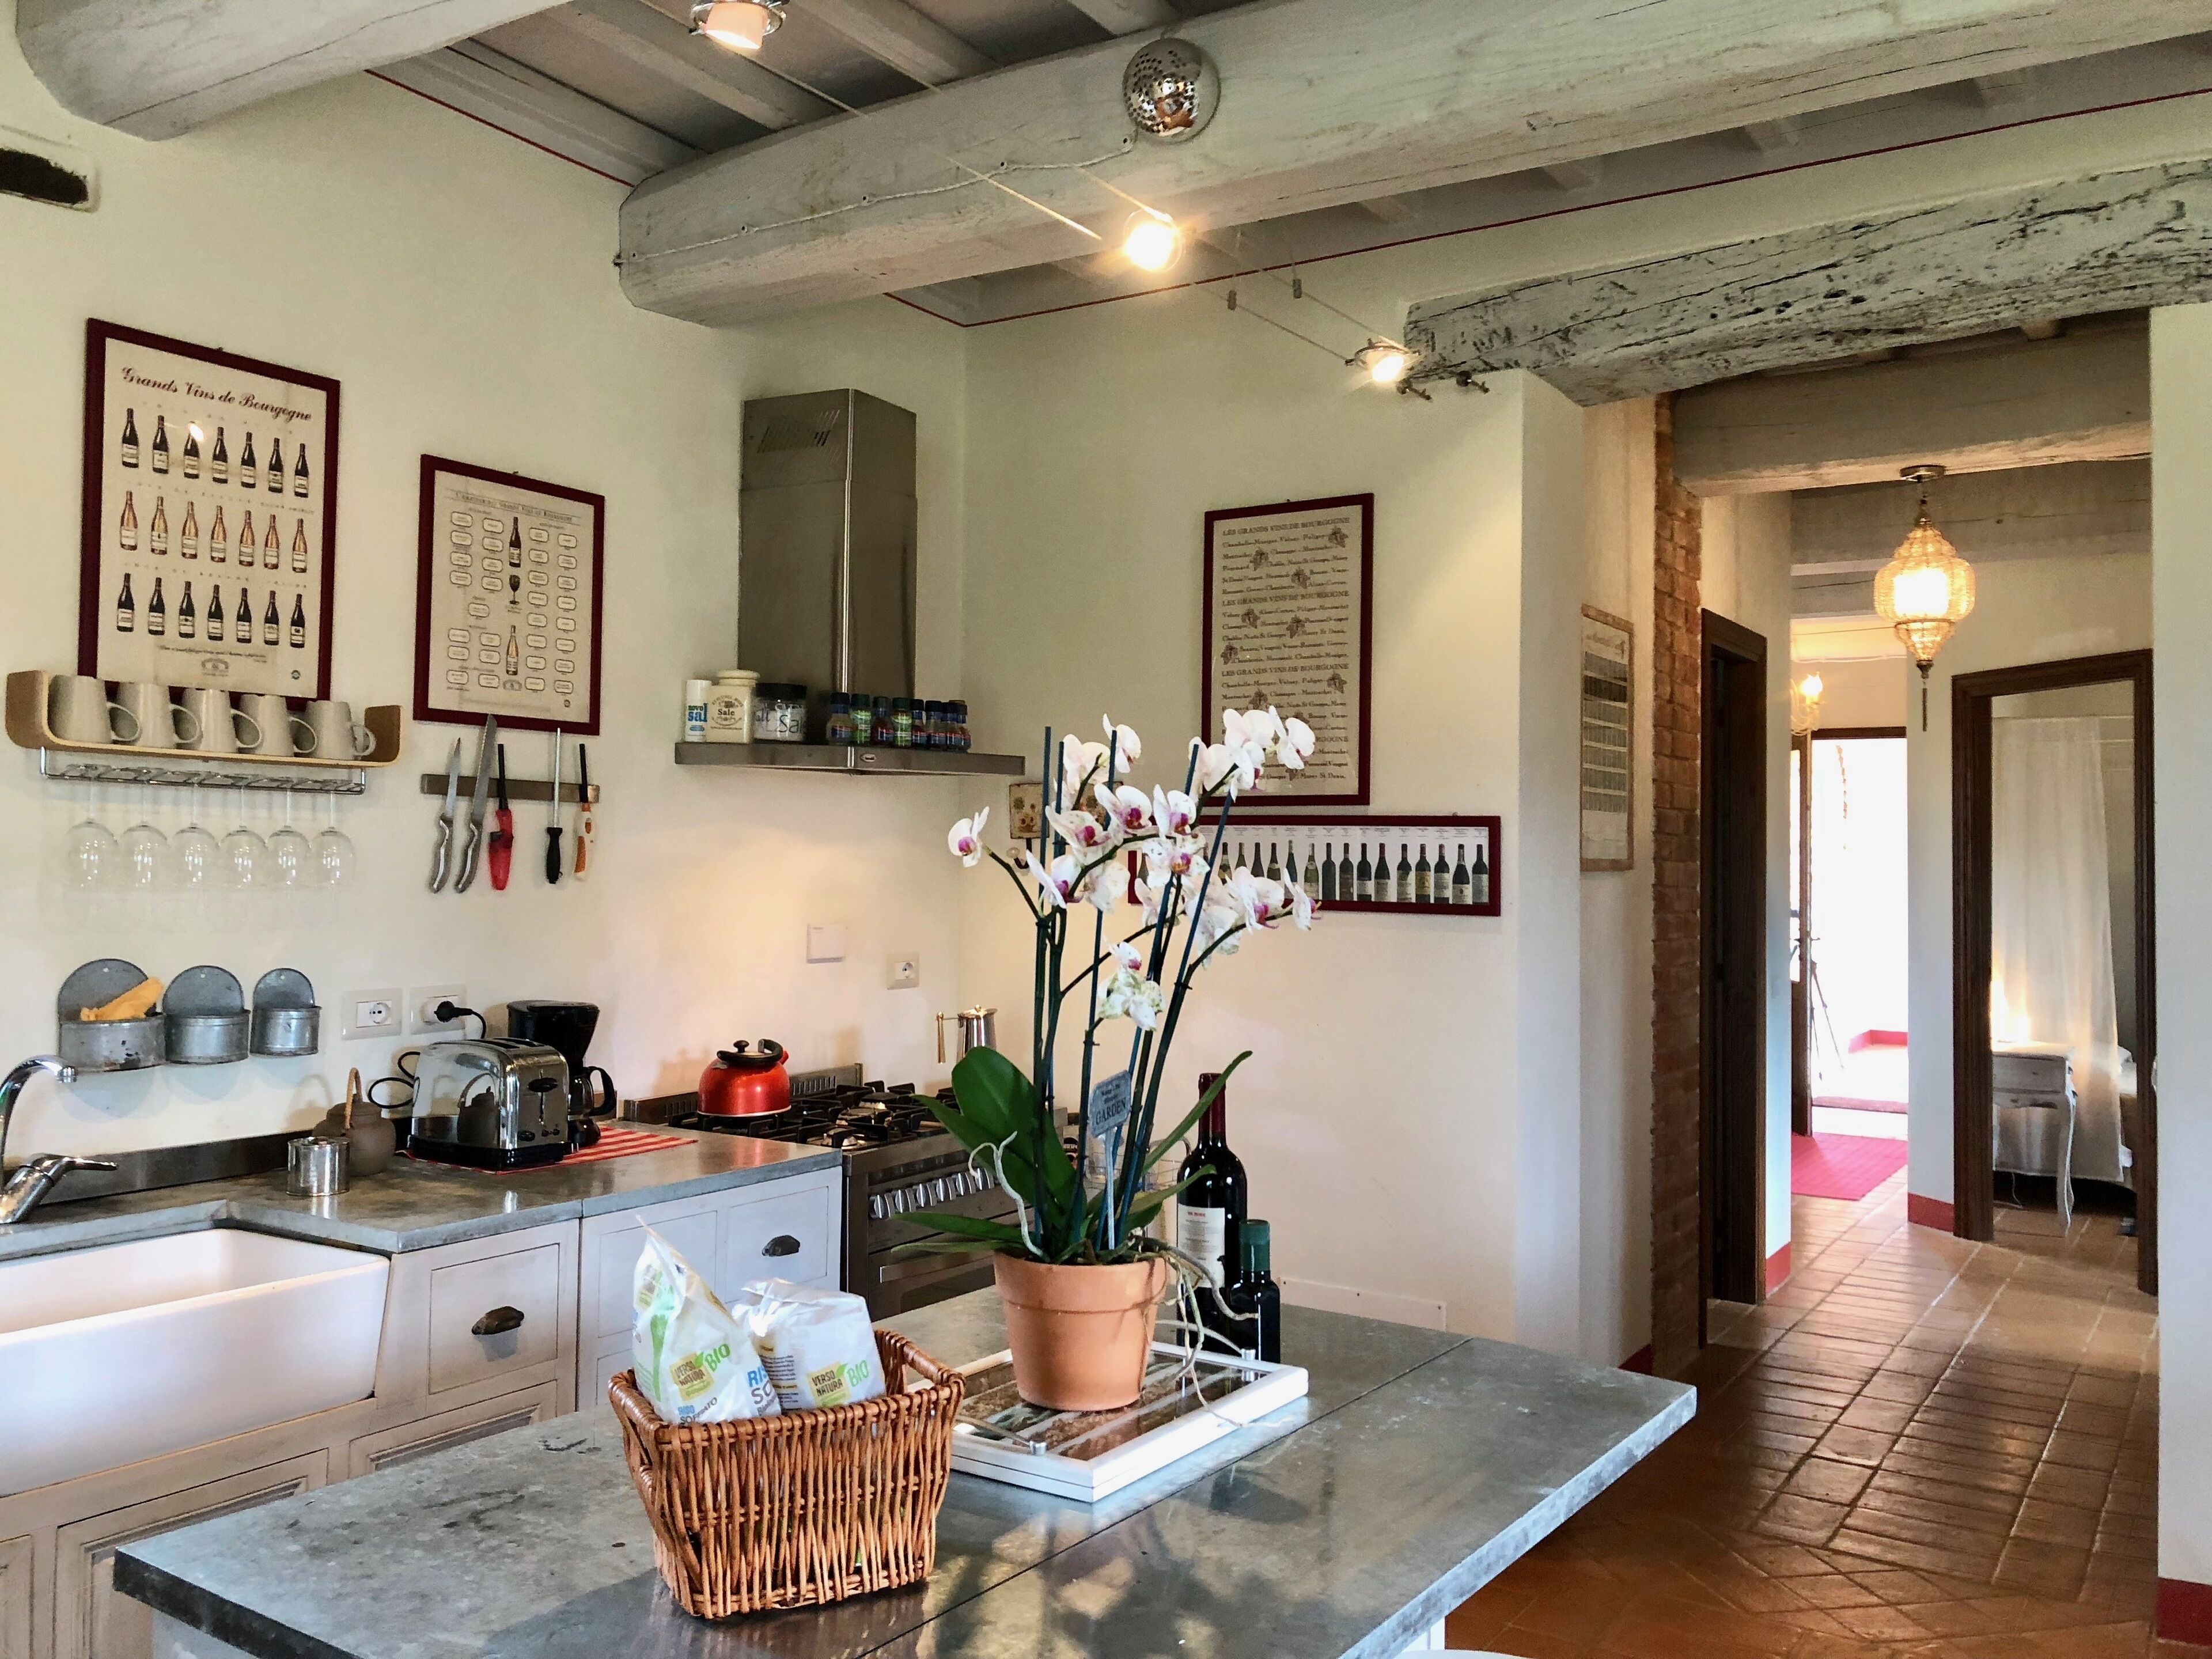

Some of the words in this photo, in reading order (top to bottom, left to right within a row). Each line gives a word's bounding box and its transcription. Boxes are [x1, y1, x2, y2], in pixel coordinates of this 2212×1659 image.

[122, 367, 177, 393] Grands
[185, 381, 215, 400] Vins
[218, 391, 235, 403] de
[238, 393, 312, 423] Bourgogne
[1237, 525, 1268, 535] GRANDS
[1301, 590, 1350, 600] BOURGOGNE
[1237, 667, 1268, 676] GRANDS
[688, 703, 709, 722] sal
[1096, 1097, 1126, 1126] GARDEN
[704, 1343, 731, 1372] BIO
[812, 1370, 835, 1386] VERSO
[847, 1360, 870, 1387] BIO
[817, 1378, 843, 1397] NATURA
